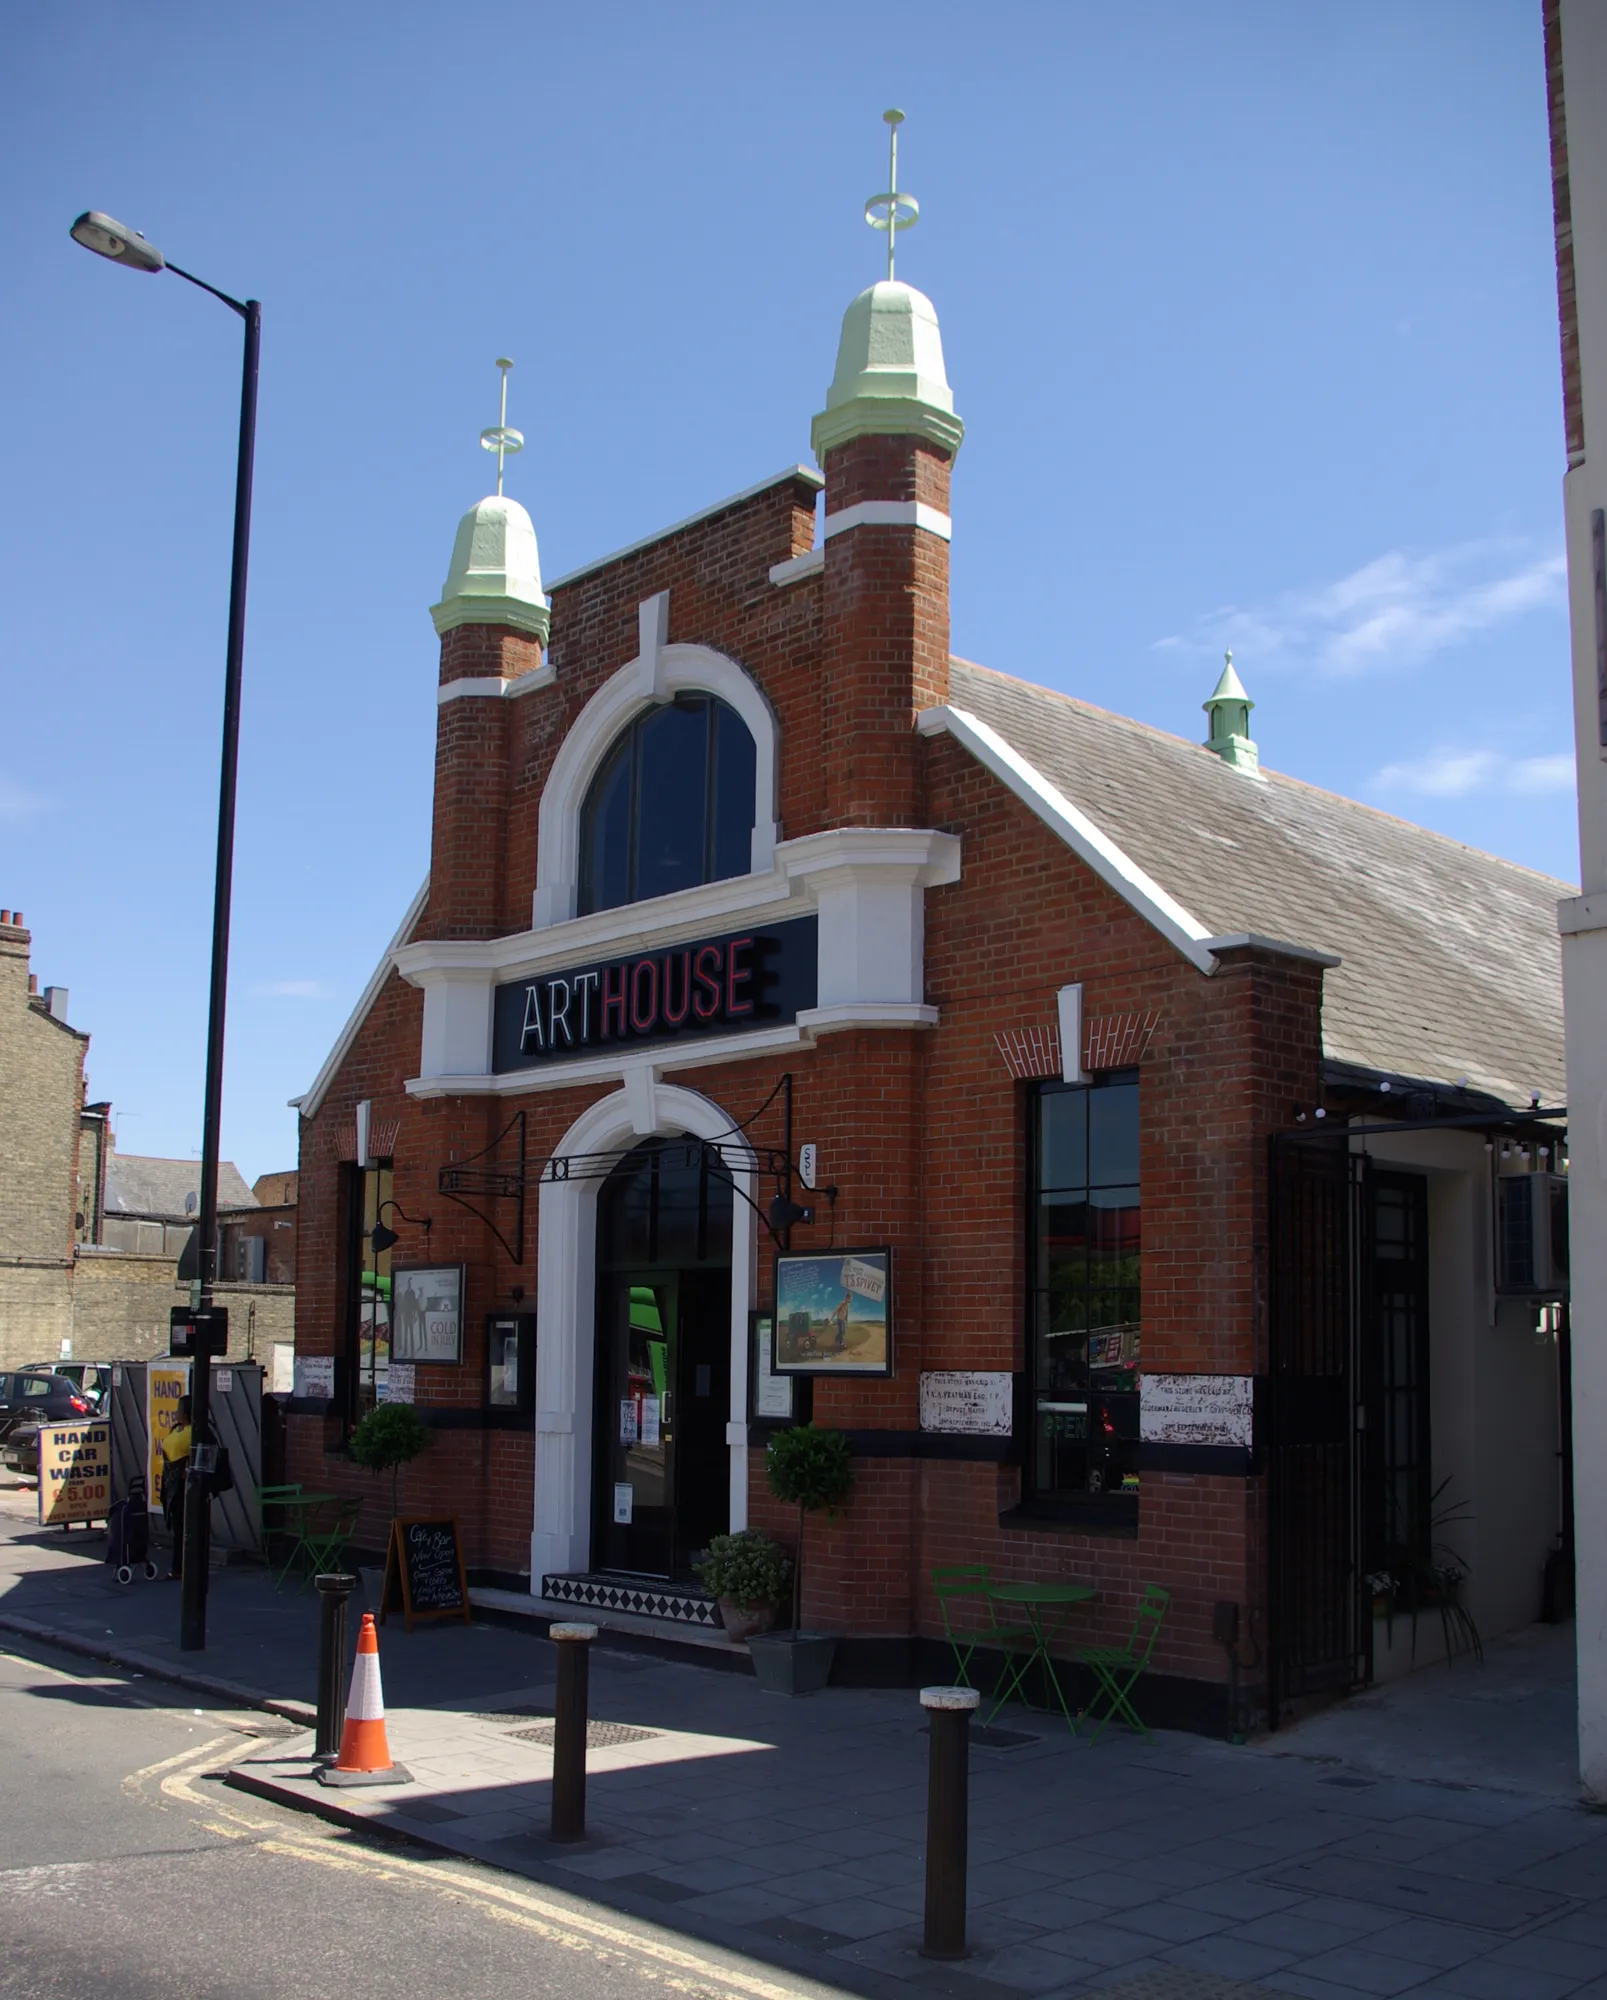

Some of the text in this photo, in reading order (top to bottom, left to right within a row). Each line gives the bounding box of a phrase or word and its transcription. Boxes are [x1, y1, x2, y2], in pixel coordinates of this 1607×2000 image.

[430, 1321, 457, 1335] COLD
[440, 1335, 456, 1347] JULY
[154, 1380, 182, 1399] HAND
[1043, 1414, 1088, 1440] OPEN
[53, 1430, 106, 1445] HAND
[58, 1448, 97, 1462] CAR
[49, 1464, 109, 1480] WASH
[431, 1531, 452, 1550] Bar
[411, 1548, 455, 1564] Now Open
